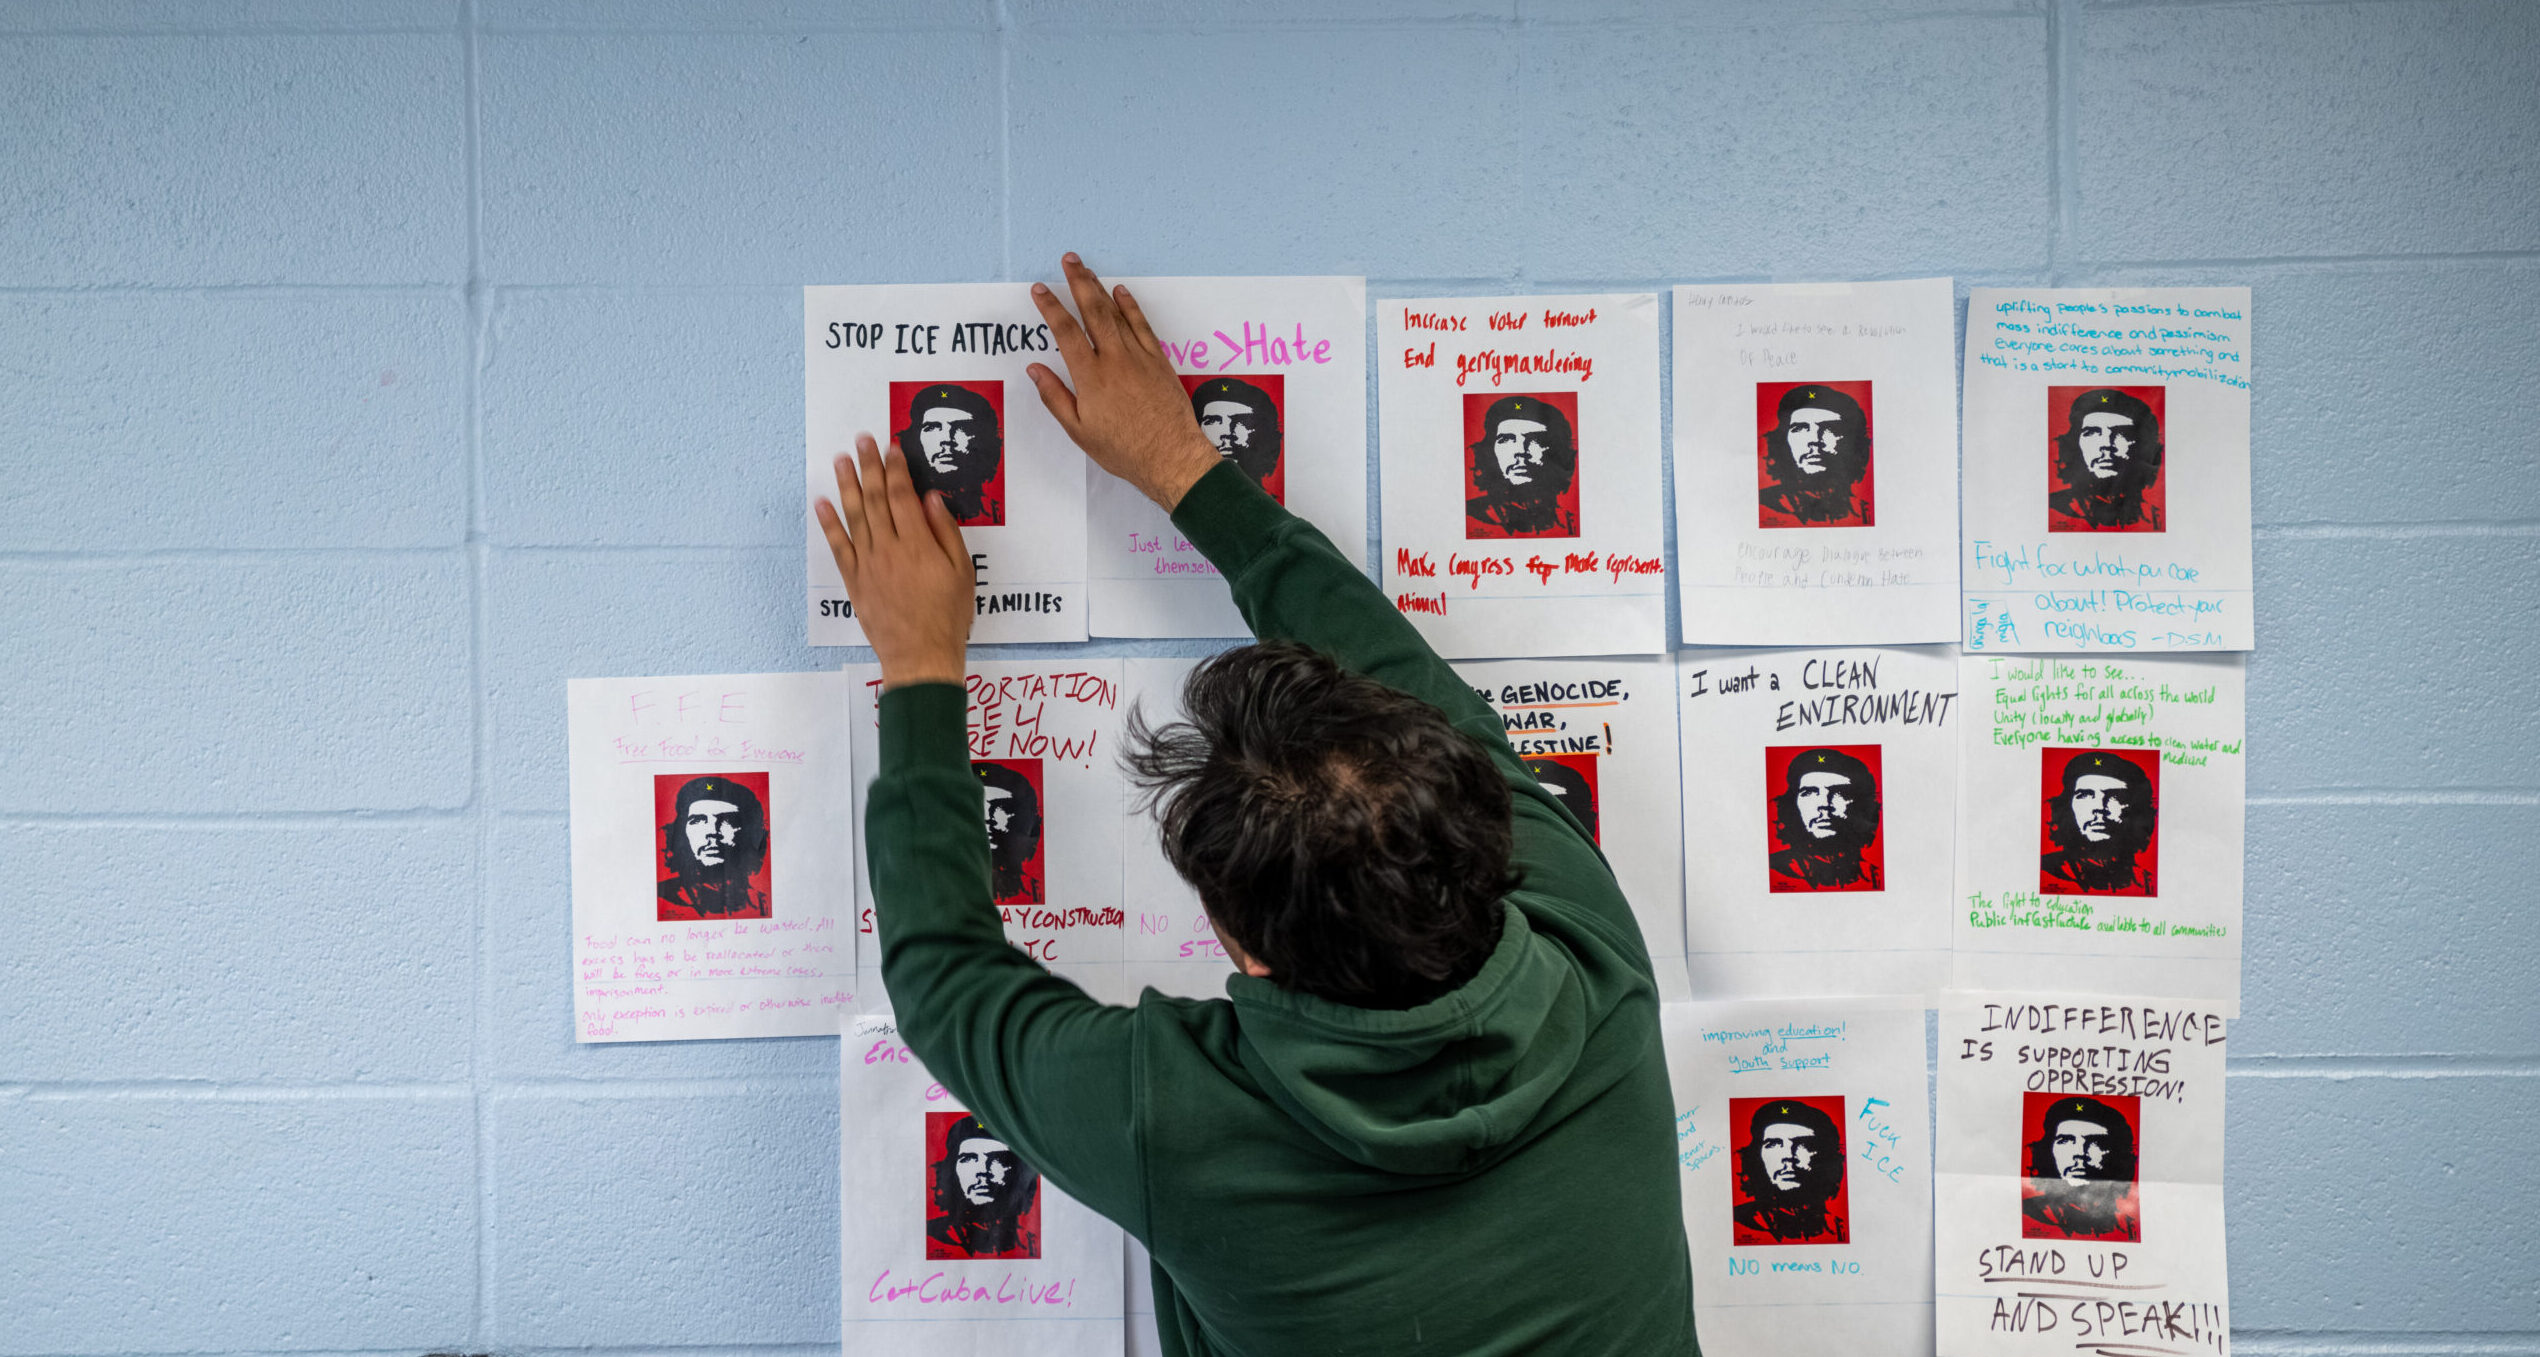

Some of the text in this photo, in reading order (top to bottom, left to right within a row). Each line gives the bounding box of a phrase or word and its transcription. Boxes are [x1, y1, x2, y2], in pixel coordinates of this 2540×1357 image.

[1404, 307, 1467, 331] Increase
[1543, 308, 1598, 329] turnout
[1995, 300, 2053, 323] uplifting
[2115, 303, 2172, 318] passions
[2176, 303, 2191, 316] to
[2193, 305, 2243, 321] combat
[826, 322, 1060, 356] STOP ICE ATTACKS
[1996, 320, 2031, 334] mass
[2037, 322, 2123, 340] indifference
[2128, 324, 2158, 340] and
[1404, 342, 1594, 387] End gerrymandering
[1979, 352, 2008, 369] that
[2059, 341, 2099, 356] cares
[2101, 342, 2143, 357] about
[2148, 344, 2215, 364] something
[2217, 349, 2241, 363] and
[1128, 533, 1162, 553] Just
[1398, 547, 1437, 577] Make
[1449, 552, 1515, 590] Congress
[1973, 539, 2030, 586] Fight
[2036, 542, 2067, 578] for
[2073, 550, 2129, 578] what
[820, 592, 1062, 618] STO FAMILIES
[2034, 589, 2106, 615] about!
[2112, 589, 2187, 616] Protect
[1690, 654, 1881, 698] I want a CLEAN
[1988, 658, 2006, 680] I
[2007, 657, 2045, 681] would
[2081, 664, 2098, 679] to
[1501, 680, 1630, 705] GENOCIDE,
[1996, 687, 2027, 710] Equal
[2098, 684, 2115, 700] all
[2159, 684, 2180, 702] the
[1503, 711, 1567, 731] WAR,
[1776, 689, 1959, 731] ENVIRONMENT
[1994, 709, 2027, 730] Unity
[2079, 703, 2103, 724] and
[1009, 729, 1098, 769] NOW!
[1993, 727, 2052, 751] Everyone
[2057, 726, 2102, 748] having
[2146, 732, 2162, 747] to
[2221, 738, 2243, 755] and
[1967, 890, 1993, 909] The
[2027, 891, 2041, 908] to
[1970, 910, 2007, 929] Public
[2138, 917, 2152, 934] to
[2152, 920, 2167, 937] all
[612, 1006, 667, 1025] exception
[1980, 1004, 2227, 1047] INDIFFERENCE
[1700, 1027, 1772, 1045] improving
[1762, 1039, 1788, 1056] and
[1961, 1038, 2172, 1075] IS SUPPORTING
[2026, 1068, 2185, 1104] OPPRESSION!
[1729, 1256, 1760, 1276] NO
[1771, 1261, 1822, 1273] means
[1979, 1245, 2128, 1280] STAND UP
[869, 1269, 1076, 1309] Let Cuba Live!
[1991, 1297, 2058, 1333] AND
